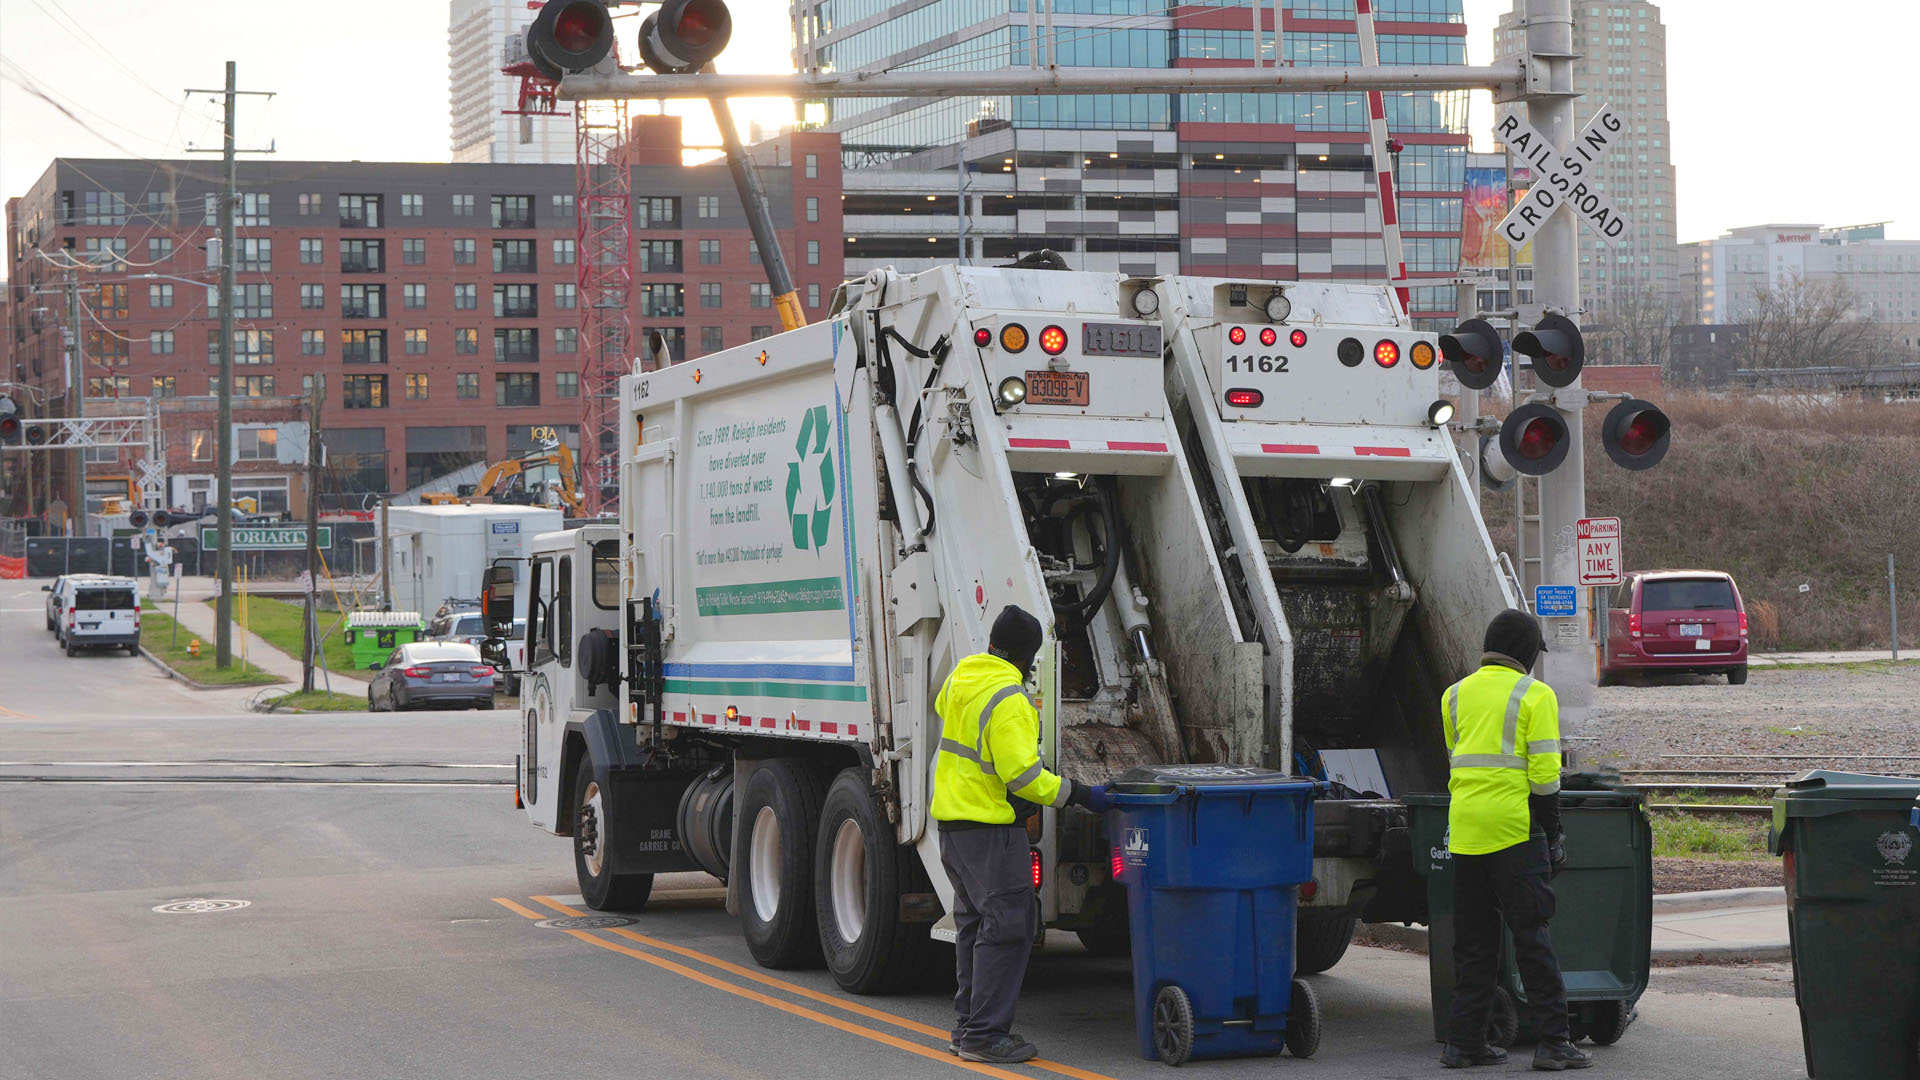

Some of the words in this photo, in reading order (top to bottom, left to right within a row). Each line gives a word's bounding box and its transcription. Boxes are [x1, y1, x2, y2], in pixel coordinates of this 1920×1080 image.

[1498, 115, 1551, 174] RAIL
[1568, 182, 1624, 238] ROAD
[1506, 113, 1621, 242] CROSSING
[1226, 355, 1289, 373] 1162
[1027, 372, 1051, 380] NORTH
[633, 380, 650, 401] 1162
[1032, 380, 1083, 398] 83098-V
[697, 430, 713, 448] Since
[714, 425, 730, 446] 1989,
[731, 420, 756, 443] Raleigh
[756, 416, 787, 438] residents
[708, 454, 724, 472] have
[724, 448, 751, 469] diverted
[751, 452, 766, 466] over
[729, 481, 743, 497] tons
[743, 475, 752, 494] of
[753, 475, 773, 492] waste
[710, 508, 724, 526] from
[725, 505, 735, 524] the
[735, 503, 760, 522] landfill.
[231, 531, 308, 543] ORIART
[1578, 523, 1590, 536] NO
[1590, 524, 1618, 534] PARKING
[1586, 542, 1611, 556] ANY
[1585, 558, 1614, 572] TIME
[639, 841, 668, 851] CARRIER
[1430, 846, 1452, 860] Garb
